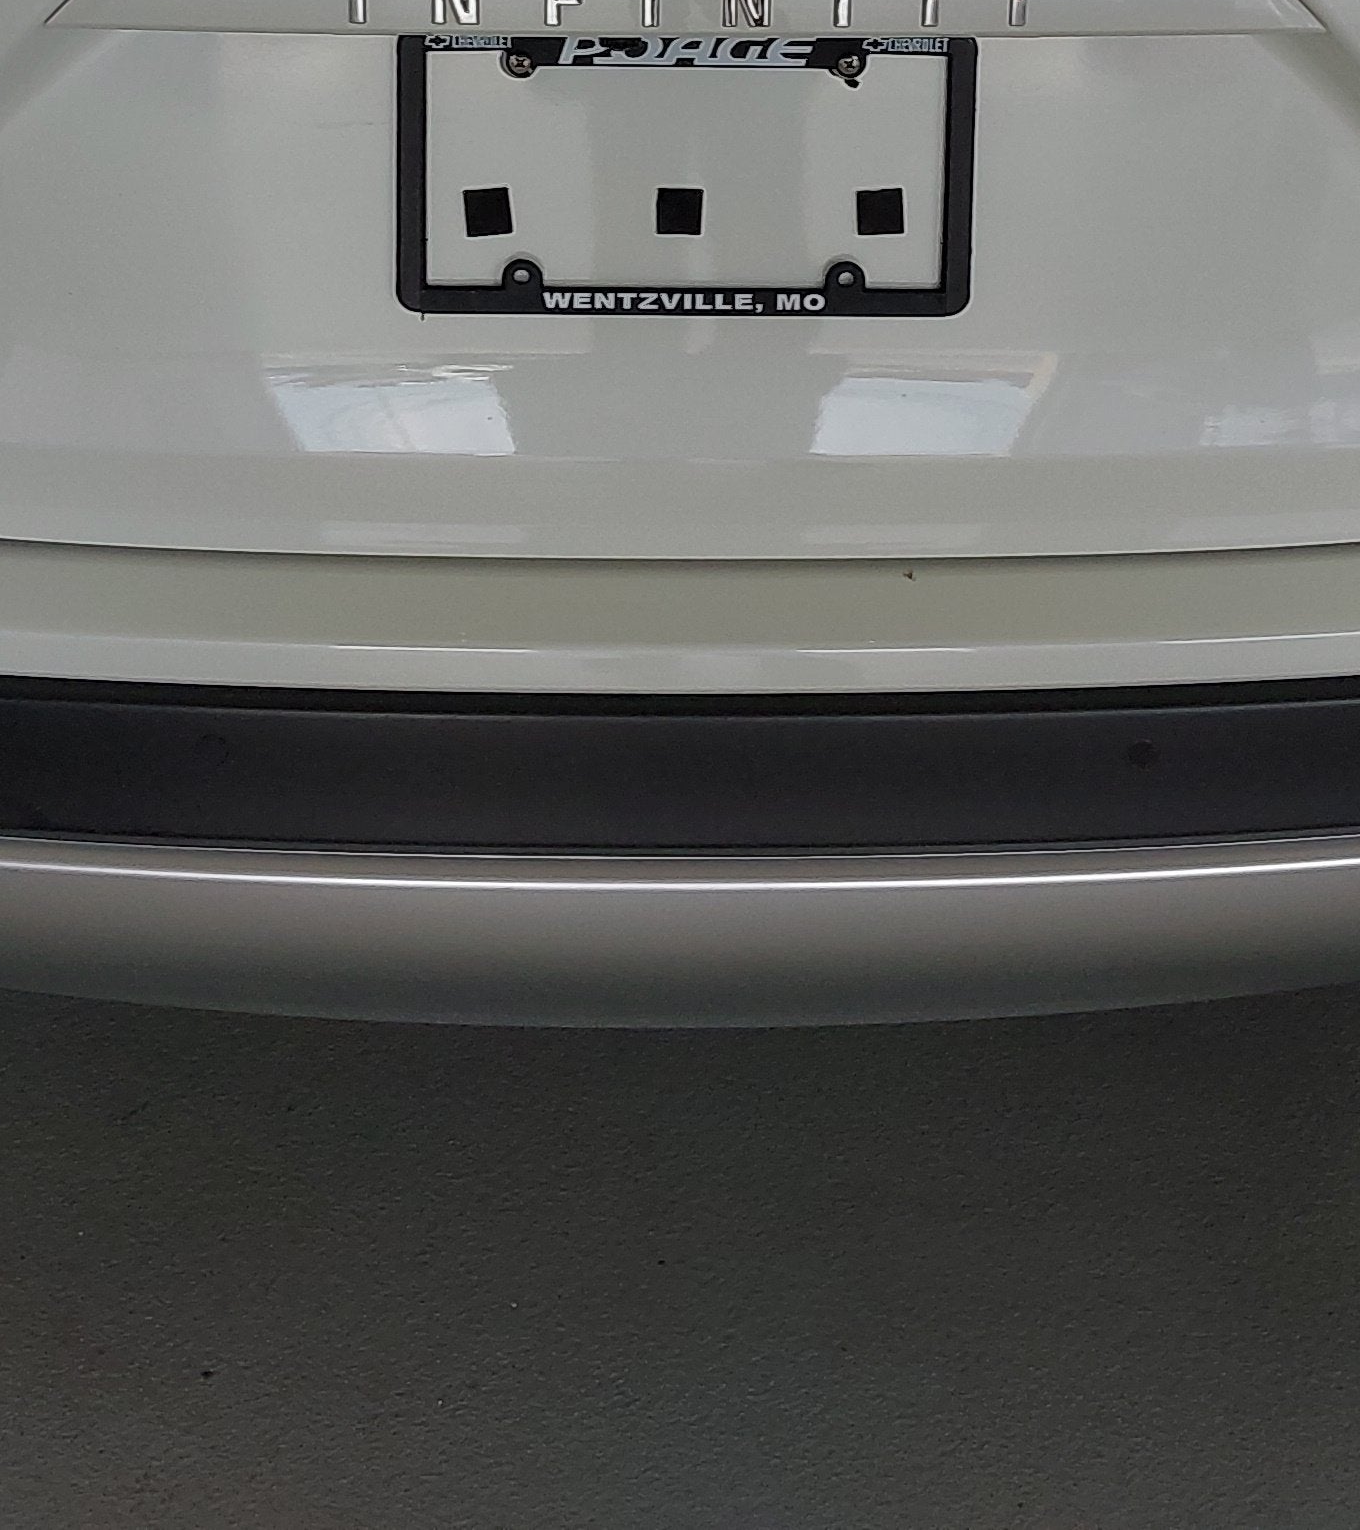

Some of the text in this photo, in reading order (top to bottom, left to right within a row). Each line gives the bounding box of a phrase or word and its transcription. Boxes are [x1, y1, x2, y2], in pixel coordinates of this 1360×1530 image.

[888, 37, 950, 52] CHEVROLET
[542, 291, 826, 313] WENTZVILLE, MO
